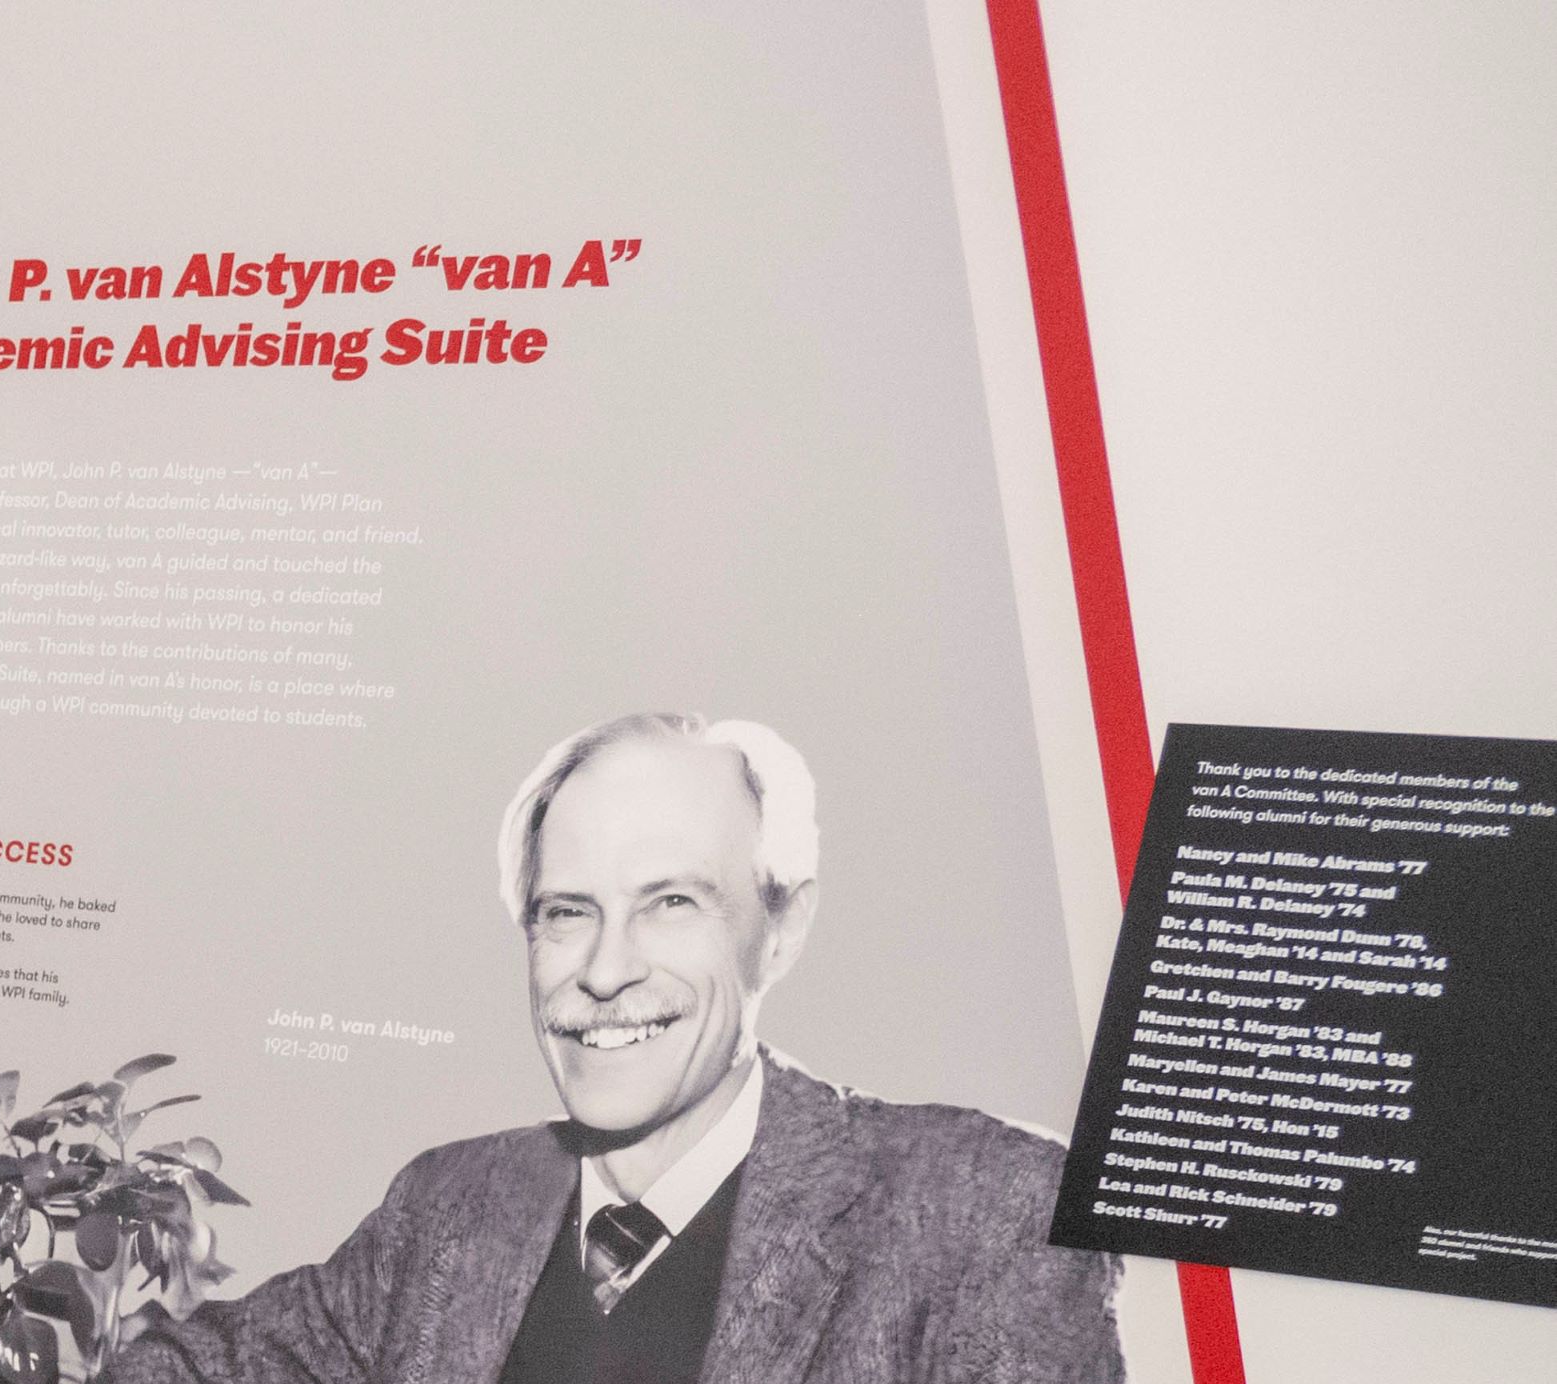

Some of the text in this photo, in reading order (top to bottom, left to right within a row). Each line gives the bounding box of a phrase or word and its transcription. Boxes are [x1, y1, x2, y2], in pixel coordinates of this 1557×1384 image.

[8, 258, 52, 303] P.
[66, 265, 163, 301] van
[172, 251, 397, 310] Alstyne
[412, 245, 552, 291] “van
[562, 238, 642, 288] A”
[123, 321, 373, 381] Advising
[380, 317, 549, 367] Suite
[55, 490, 99, 509] Dean
[103, 491, 122, 509] of
[124, 492, 210, 510] Academic
[214, 492, 294, 516] Advising,
[300, 493, 337, 511] WPI
[341, 493, 383, 512] Plan
[21, 519, 101, 540] innovator,
[107, 524, 149, 541] tutor,
[155, 522, 245, 547] colleague,
[250, 526, 316, 544] mentor,
[322, 525, 360, 543] and
[364, 524, 423, 544] friend.
[1198, 761, 1519, 791] Thank you to the dedicated members of the
[1192, 784, 1556, 817] van A Committee. With special recognition to the
[1187, 804, 1510, 838] following alumni for their generous support:
[1177, 845, 1235, 865] Nancy
[1235, 851, 1271, 864] and
[1272, 852, 1320, 868] Mike
[1320, 855, 1395, 873] Abrams
[1171, 871, 1223, 888] Paula
[1224, 875, 1248, 889] M.
[1250, 877, 1327, 898] Delaney
[1359, 886, 1397, 900] and
[59, 897, 74, 909] he
[77, 898, 116, 913] baked
[1167, 890, 1235, 907] William
[1237, 895, 1257, 909] R.
[1259, 897, 1336, 918] Delaney
[15, 912, 48, 926] loved
[51, 916, 63, 928] to
[66, 917, 101, 931] share
[1160, 916, 1186, 930] Dr.
[1188, 918, 1204, 931] &
[1206, 919, 1249, 935] Mrs.
[1252, 923, 1340, 942] Raymond
[1341, 929, 1392, 946] Dunn
[1156, 934, 1203, 953] Kate,
[1206, 939, 1289, 959] Meaghan
[1320, 950, 1357, 963] and
[1358, 951, 1417, 968] Sarah
[13, 968, 39, 982] that
[41, 970, 59, 984] his
[1150, 960, 1235, 979] Gretchen
[1236, 969, 1272, 982] and
[1273, 970, 1330, 990] Barry
[1331, 975, 1409, 995] Fougere
[1, 985, 26, 999] WPI
[29, 988, 69, 1008] family.
[1144, 985, 1186, 1001] Paul
[1186, 989, 1203, 1002] J.
[1206, 990, 1274, 1009] Gaynor
[267, 1009, 455, 1046] John P. van Alstyne
[1138, 1010, 1220, 1030] Maureen
[1221, 1018, 1240, 1032] S.
[1242, 1020, 1311, 1040] Horgan
[1344, 1032, 1382, 1045] and
[264, 1037, 349, 1062] 1921–2010
